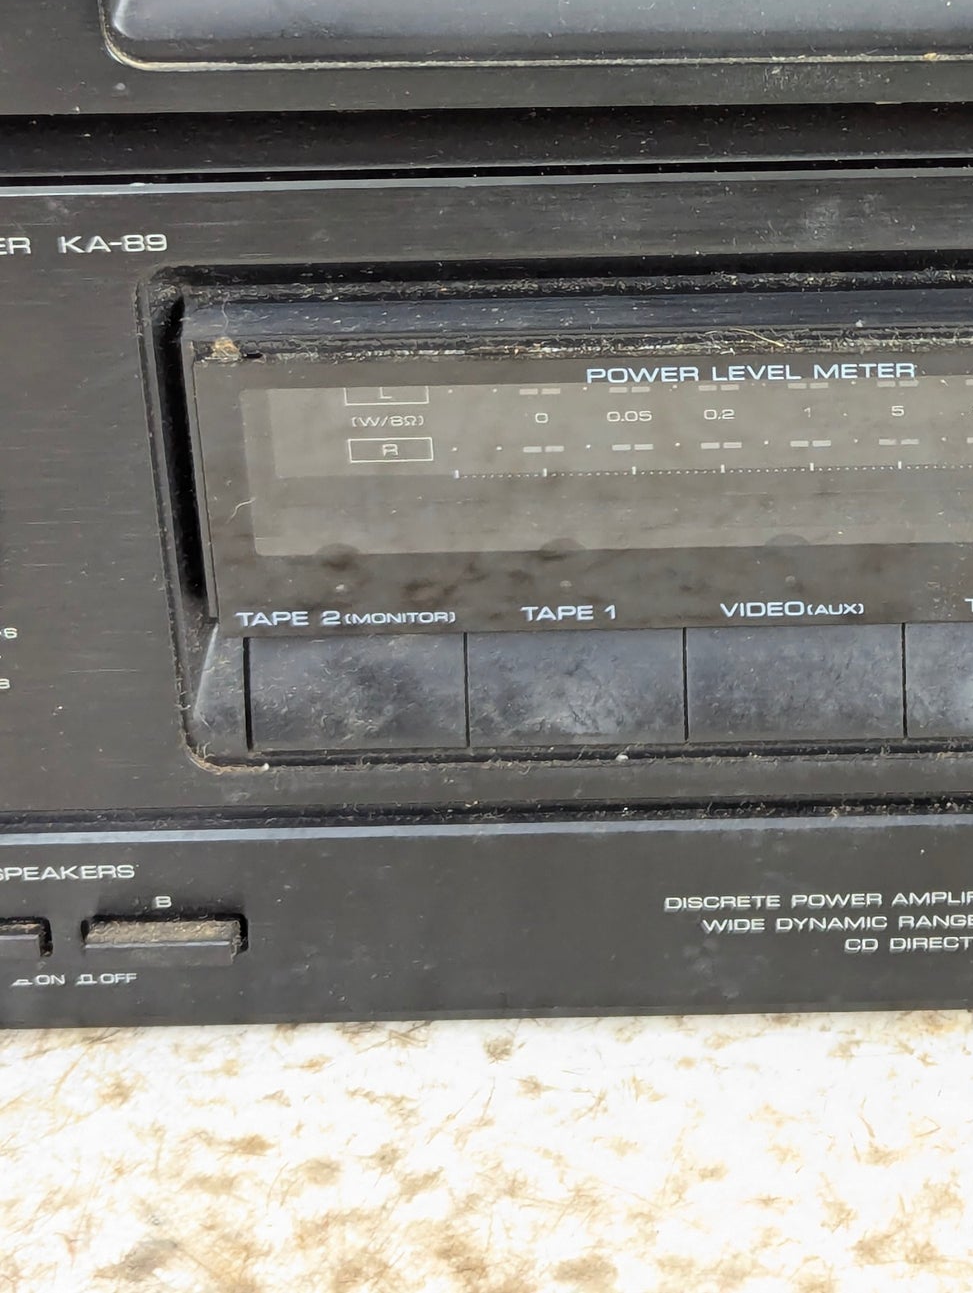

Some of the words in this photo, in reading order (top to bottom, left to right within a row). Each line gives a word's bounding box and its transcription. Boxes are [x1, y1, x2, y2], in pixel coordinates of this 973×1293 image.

[59, 233, 168, 254] KA-89
[586, 366, 699, 384] POWER
[711, 364, 802, 382] LEVEL
[813, 362, 915, 381] METER
[534, 412, 549, 424] 0
[606, 410, 653, 422] 0.05
[703, 408, 735, 420] 0.2
[891, 405, 905, 417] 5
[381, 443, 399, 457] R
[235, 611, 310, 627] TAPE
[520, 605, 594, 622] TAPE
[604, 604, 616, 620] 1
[154, 895, 172, 909] B
[664, 894, 781, 911] DISCRETE
[791, 892, 883, 909] POWER
[702, 918, 766, 933] WIDE
[775, 915, 888, 931] DYNAMIC
[844, 938, 879, 952] CD
[889, 936, 973, 951] DIRECT
[34, 974, 66, 986] ON
[98, 972, 137, 985] OFF
